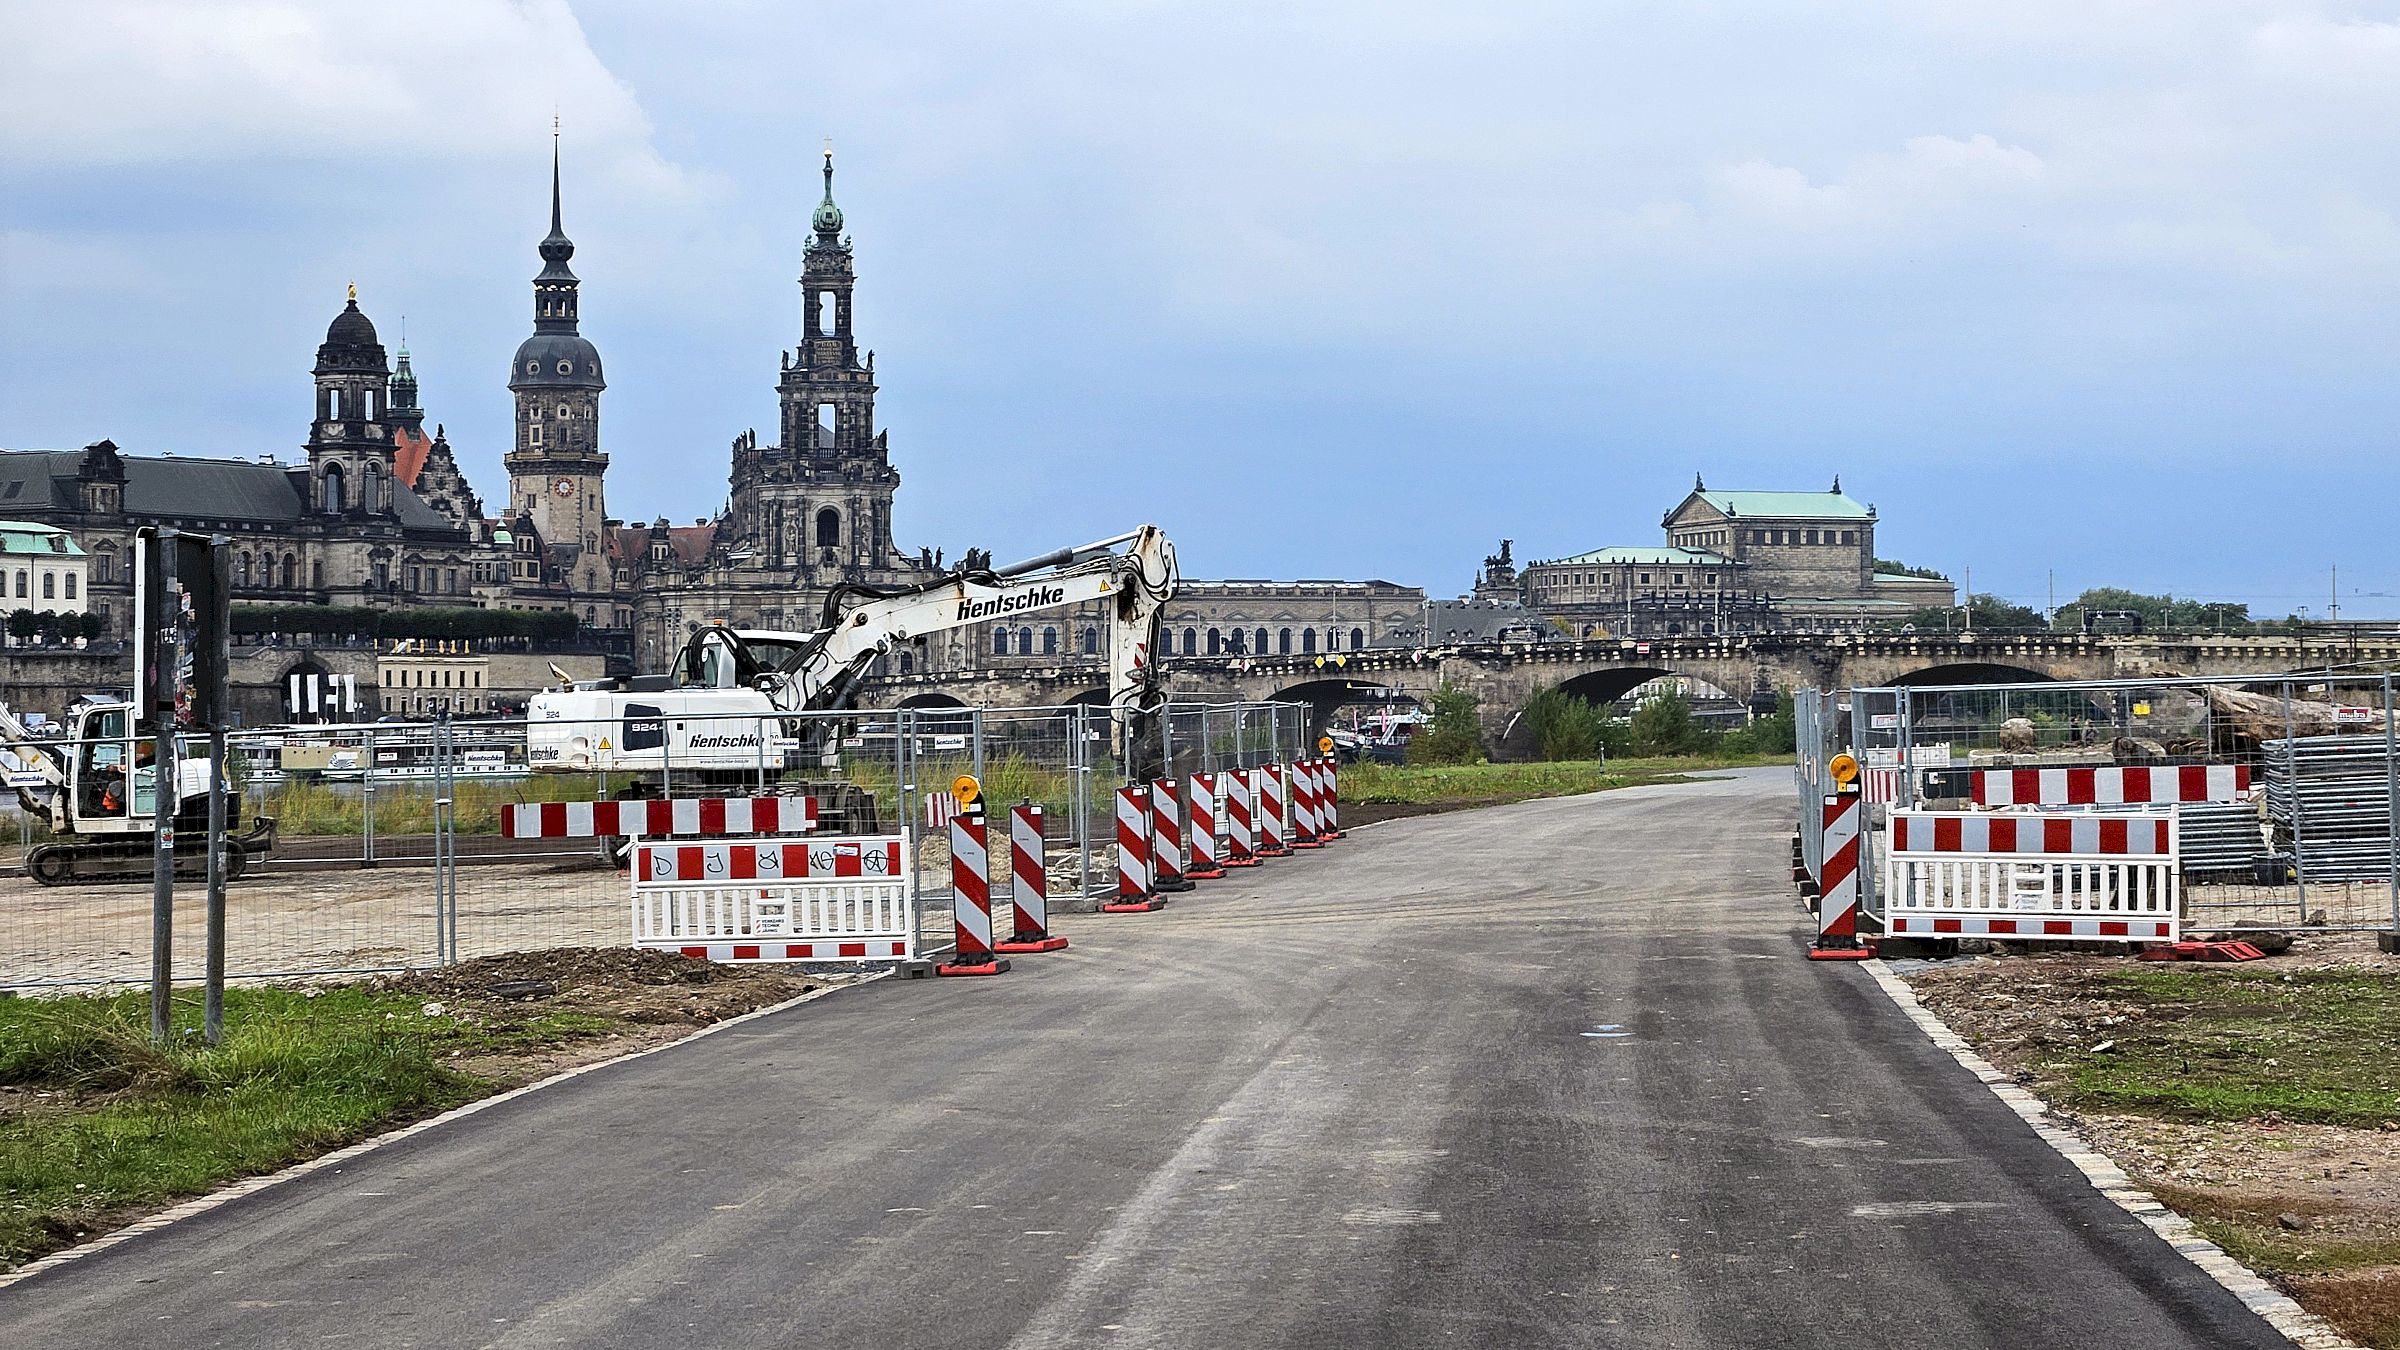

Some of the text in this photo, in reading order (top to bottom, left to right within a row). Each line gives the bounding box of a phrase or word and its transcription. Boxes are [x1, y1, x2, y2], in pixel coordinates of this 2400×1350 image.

[957, 585, 1064, 621] Hentschke
[689, 734, 765, 748] Hentschke
[467, 754, 504, 762] Hentschke
